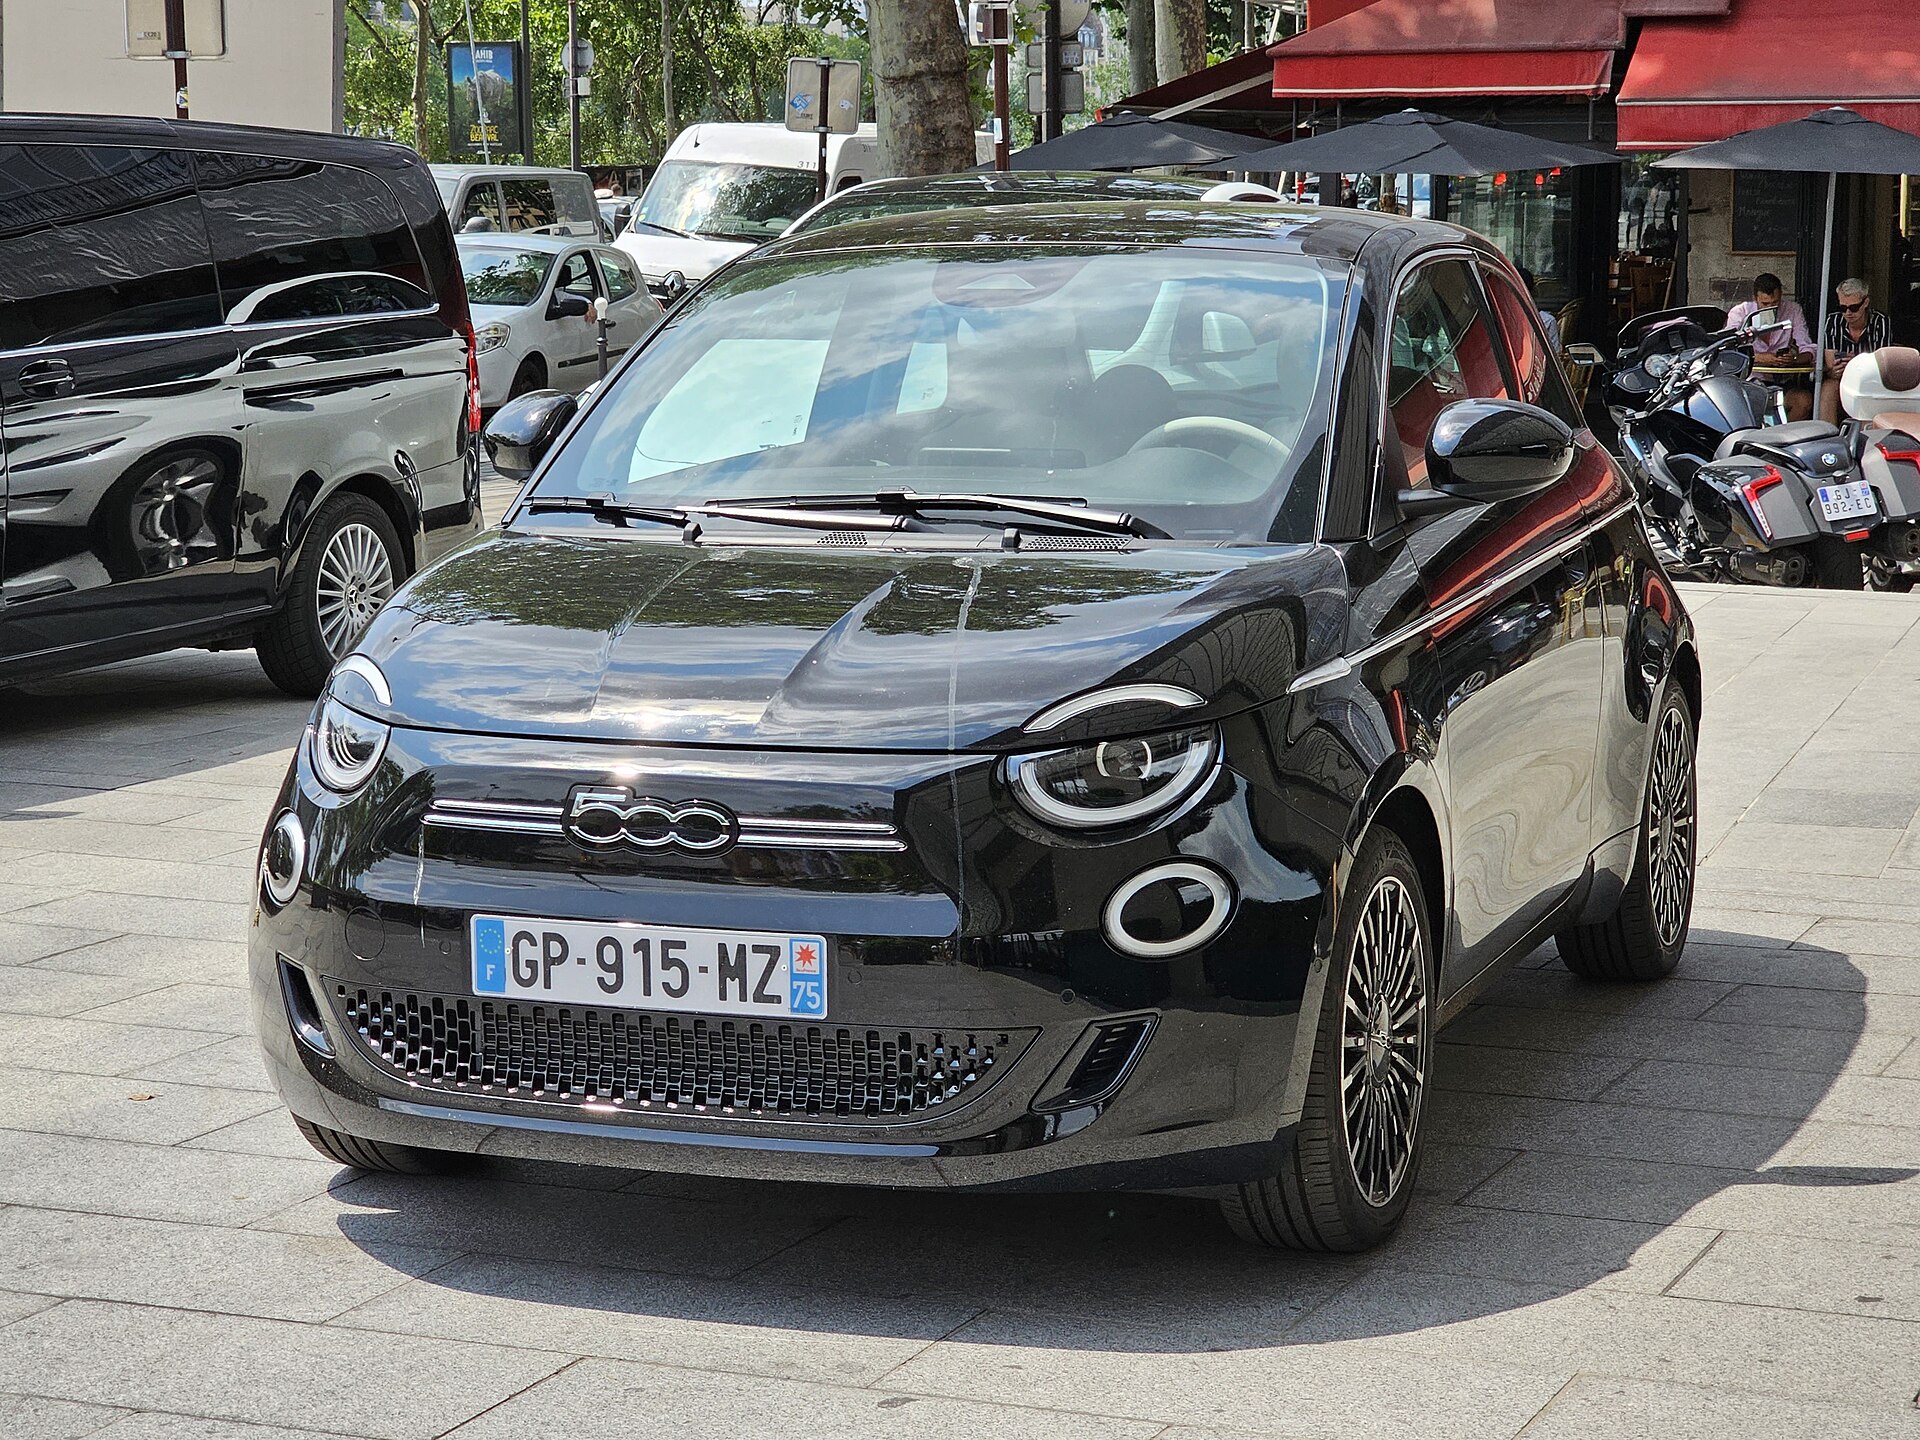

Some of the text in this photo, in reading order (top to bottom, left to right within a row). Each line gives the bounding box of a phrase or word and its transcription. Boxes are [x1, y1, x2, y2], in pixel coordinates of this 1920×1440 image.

[797, 160, 817, 170] 311
[569, 792, 730, 850] 500
[486, 930, 782, 1005] F GP-915-MZ
[792, 980, 821, 1010] 75
